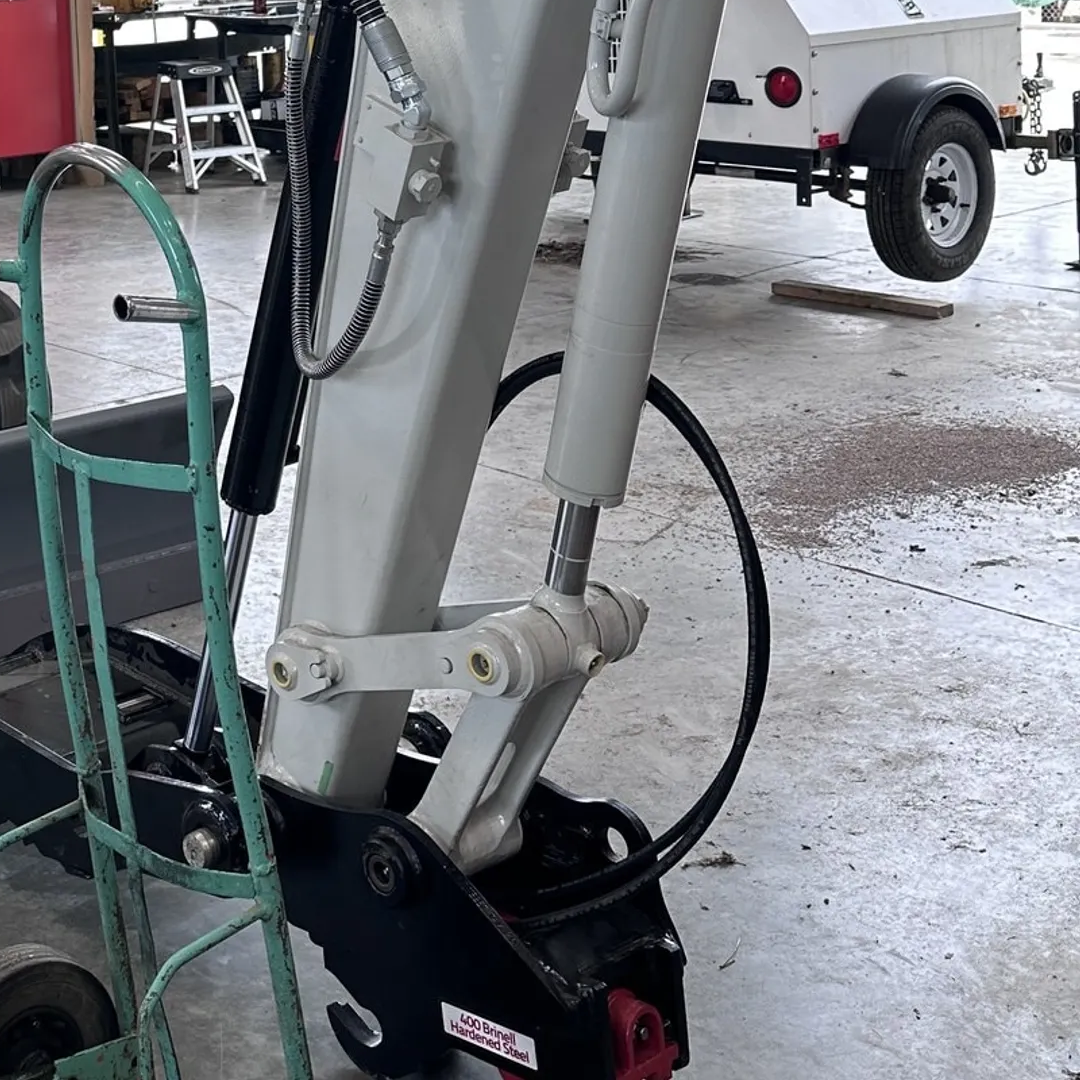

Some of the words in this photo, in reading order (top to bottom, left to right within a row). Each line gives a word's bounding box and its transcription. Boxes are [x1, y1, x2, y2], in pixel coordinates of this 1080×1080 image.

[449, 1019, 501, 1051] Hardened
[502, 1041, 531, 1064] Steel
[460, 1012, 481, 1031] 400
[482, 1021, 517, 1046] Brinell
